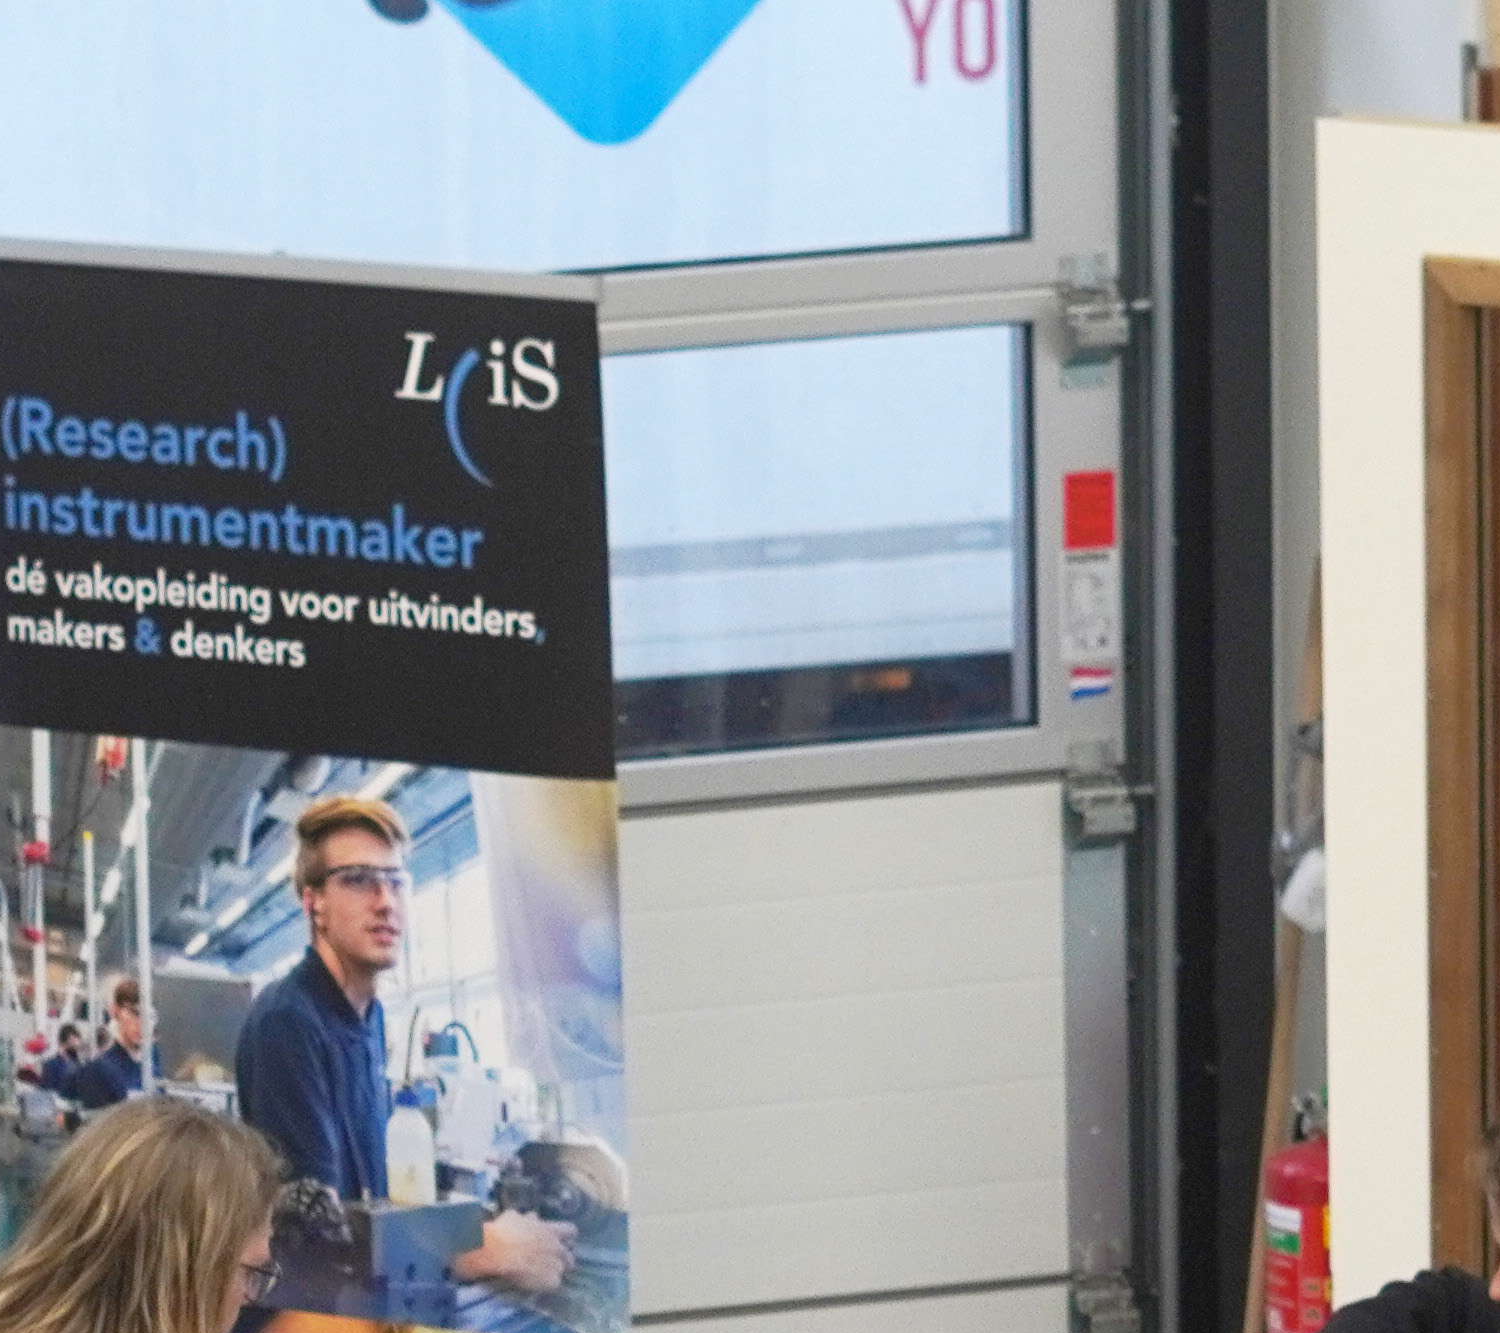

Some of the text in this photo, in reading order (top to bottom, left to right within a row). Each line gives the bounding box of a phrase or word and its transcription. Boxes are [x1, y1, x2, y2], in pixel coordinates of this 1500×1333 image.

[1, 396, 288, 484] (Research)
[3, 475, 486, 570] instrumentmaker
[5, 556, 546, 644] dé vakopleiding voor uitvinders,
[6, 608, 307, 668] makers & denkers
